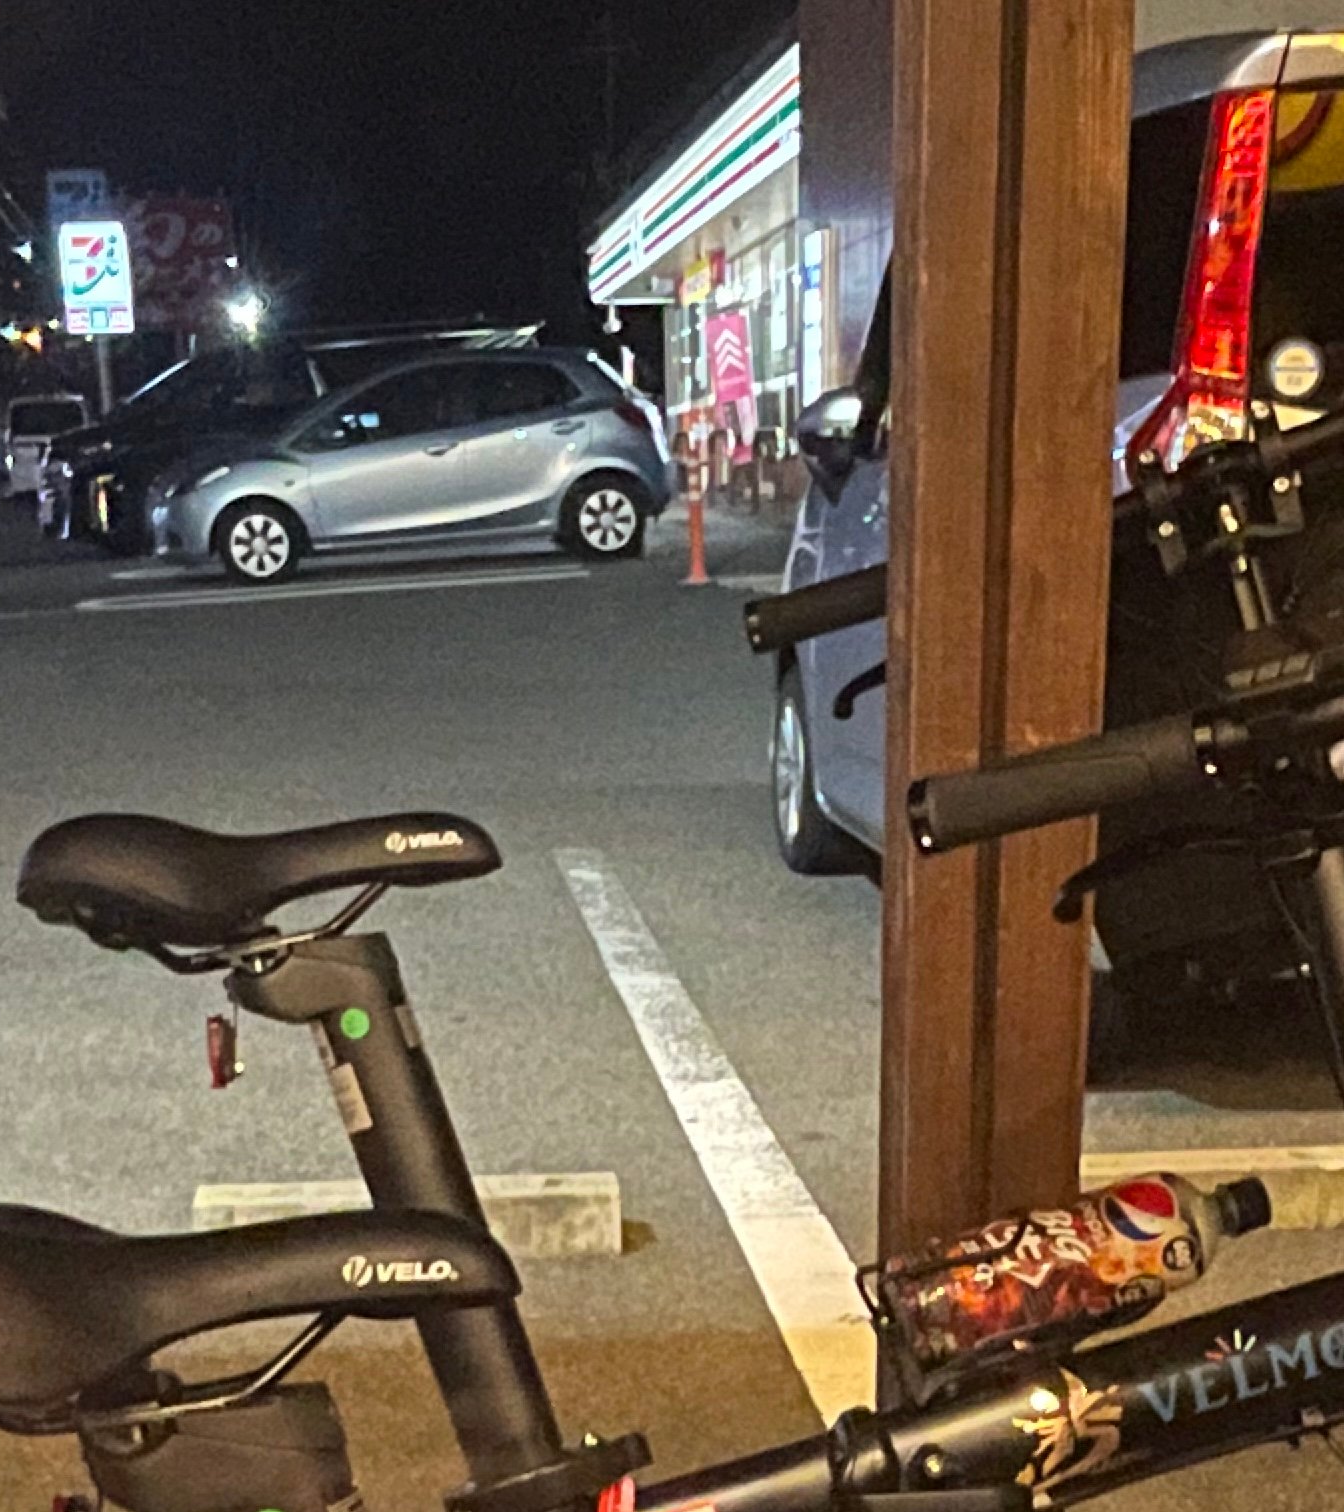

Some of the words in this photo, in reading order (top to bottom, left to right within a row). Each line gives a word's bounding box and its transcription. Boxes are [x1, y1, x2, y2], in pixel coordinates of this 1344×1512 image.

[408, 830, 458, 849] VELO
[1029, 1210, 1093, 1263] BIG
[376, 1259, 453, 1282] VELO
